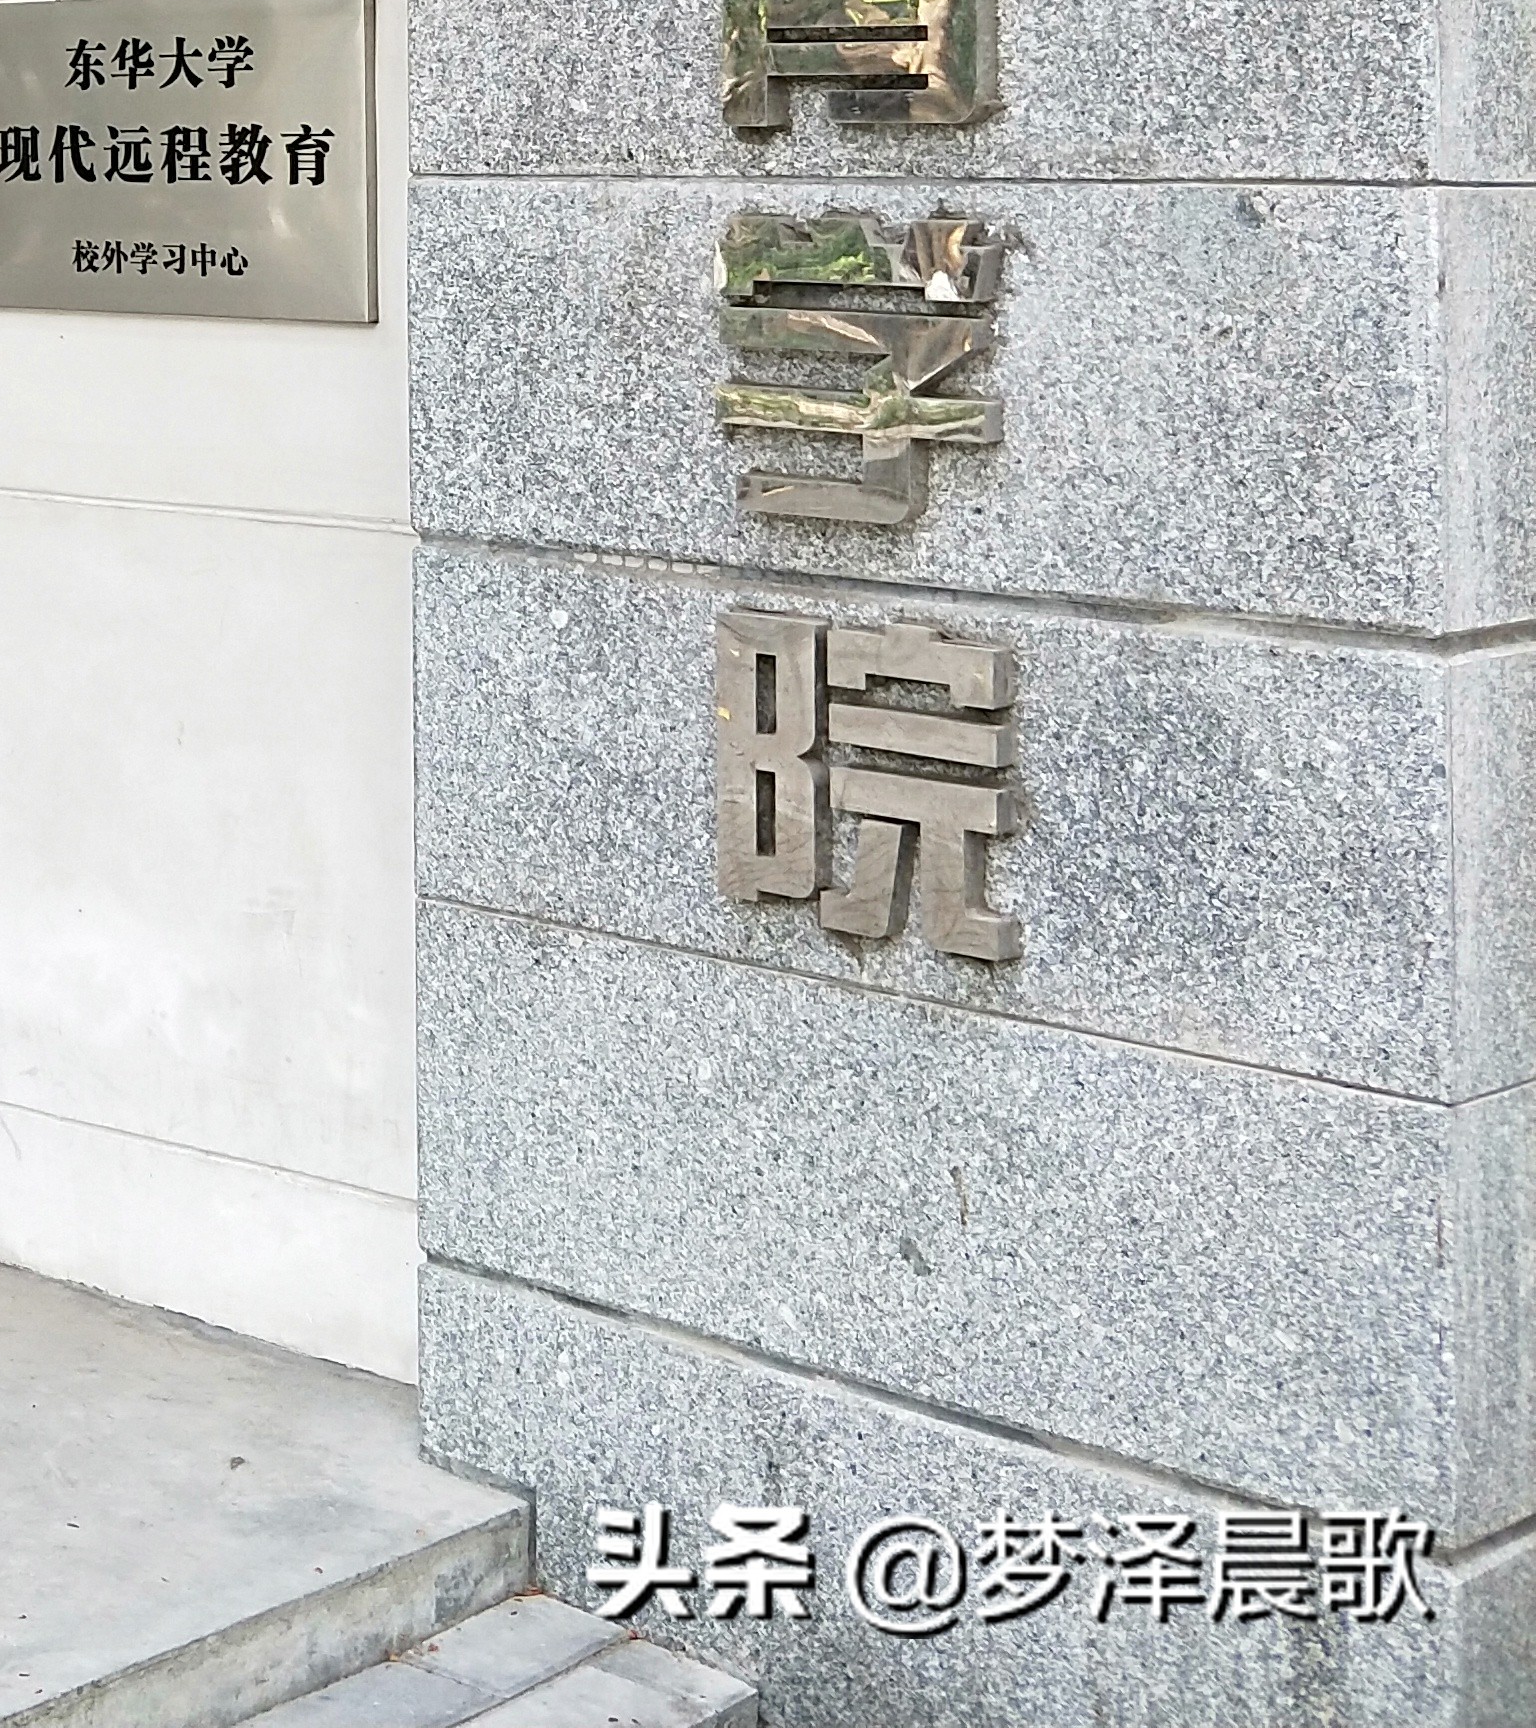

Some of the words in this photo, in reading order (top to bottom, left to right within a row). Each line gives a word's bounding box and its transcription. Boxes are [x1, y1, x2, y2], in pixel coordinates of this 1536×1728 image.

[64, 35, 254, 91] 东华大学
[71, 239, 249, 277] 校外学习中心
